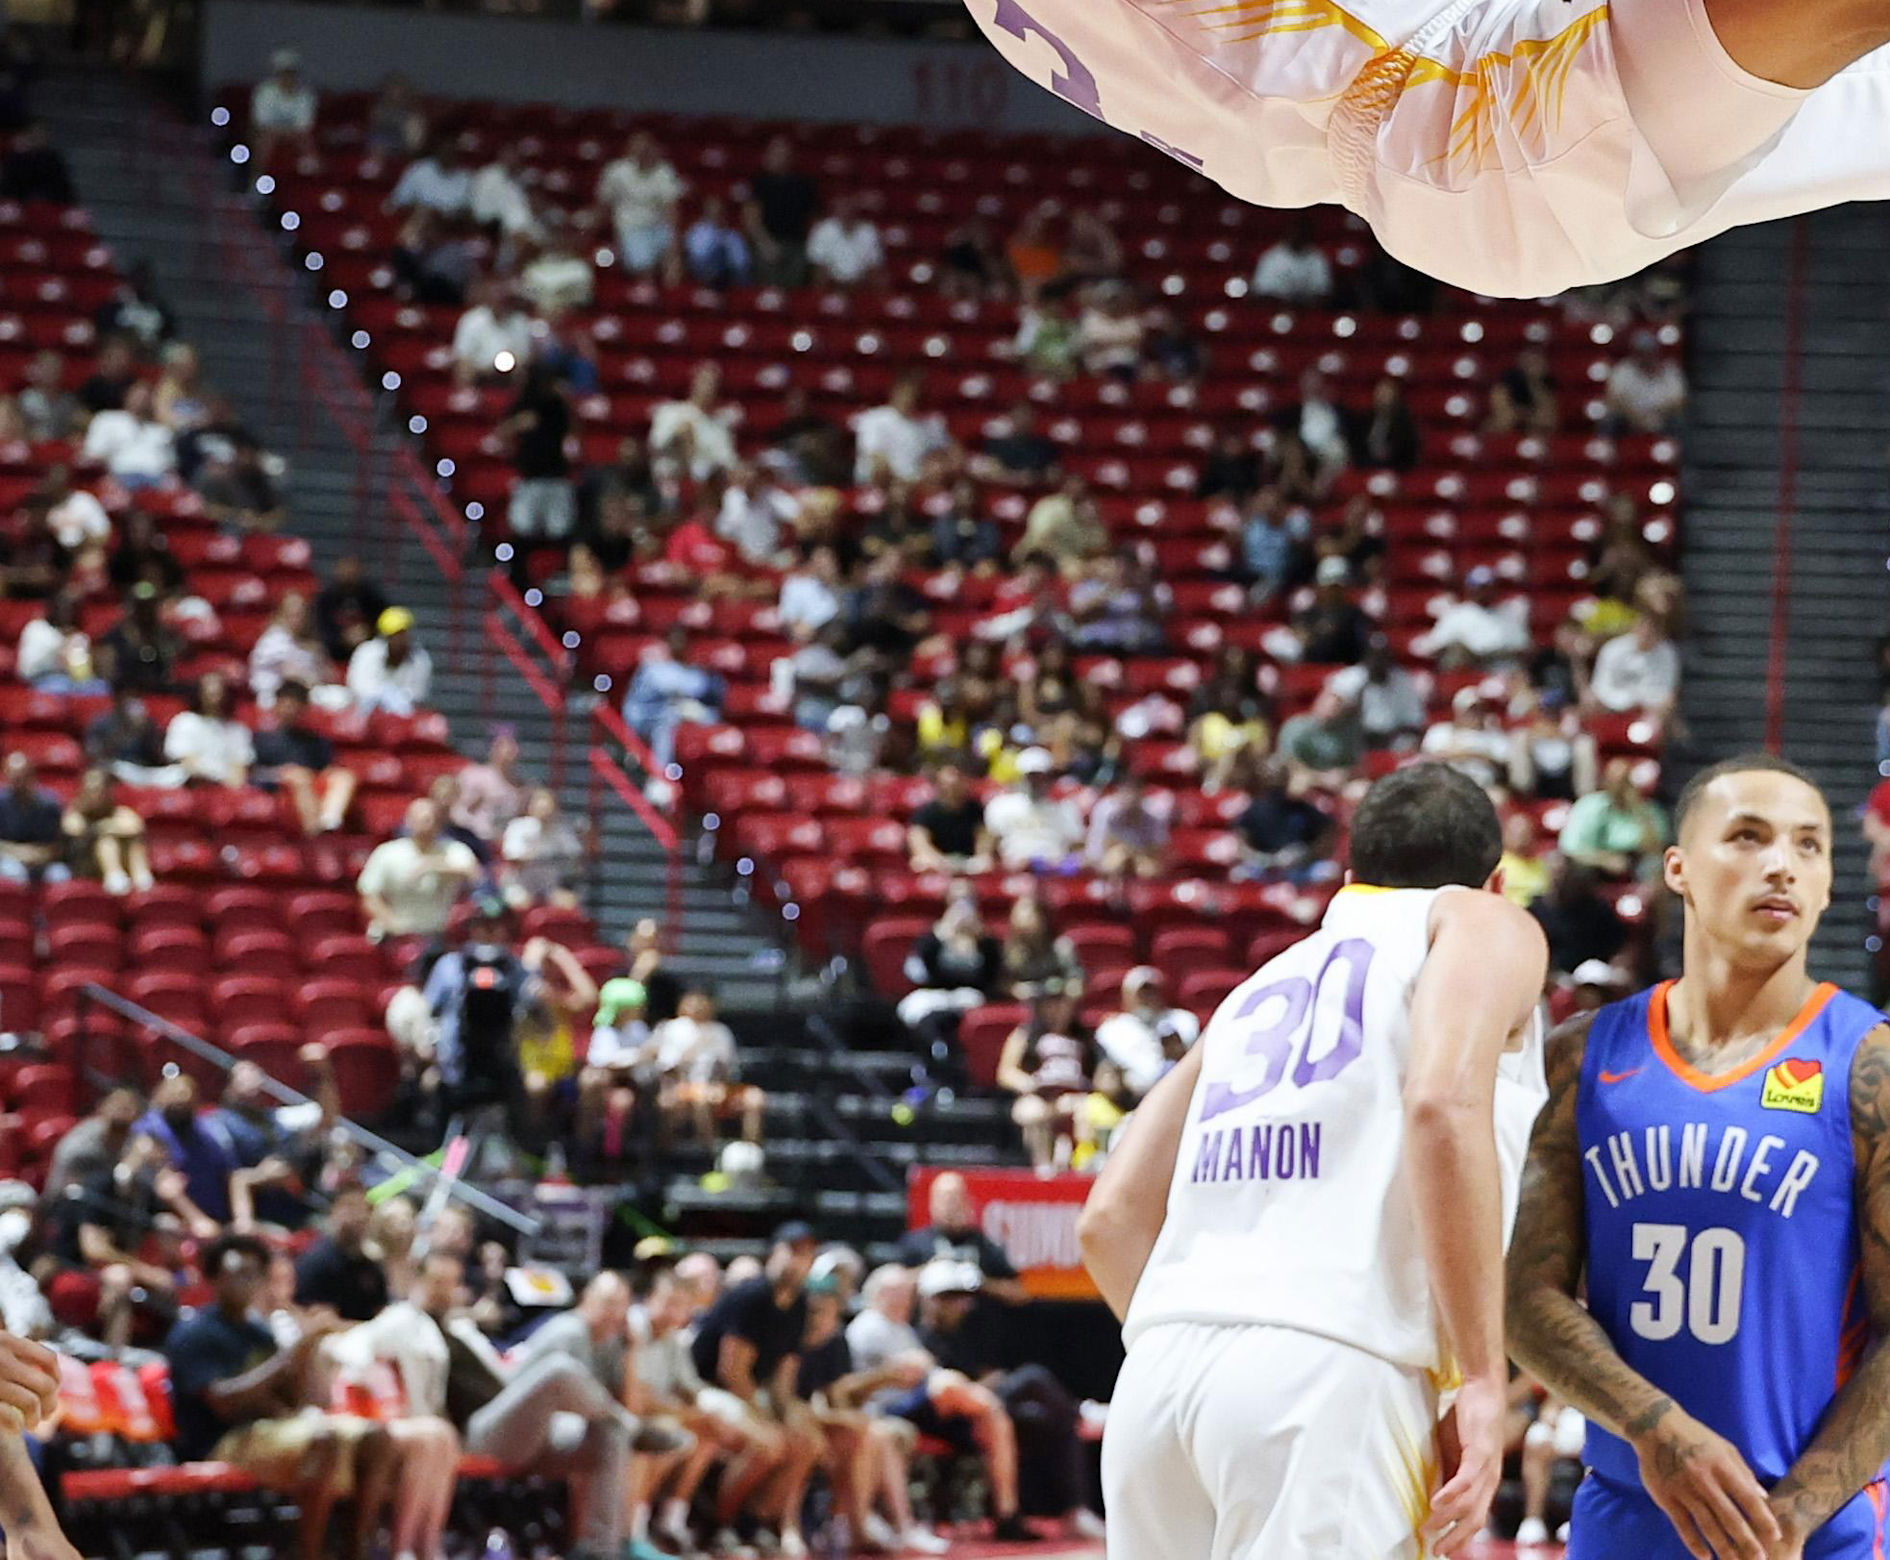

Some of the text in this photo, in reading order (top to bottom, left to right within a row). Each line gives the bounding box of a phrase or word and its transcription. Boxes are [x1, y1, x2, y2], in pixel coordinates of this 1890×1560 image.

[1198, 937, 1376, 1124] 30
[1584, 1122, 1820, 1220] THUNDER
[1630, 1222, 1746, 1346] 30
